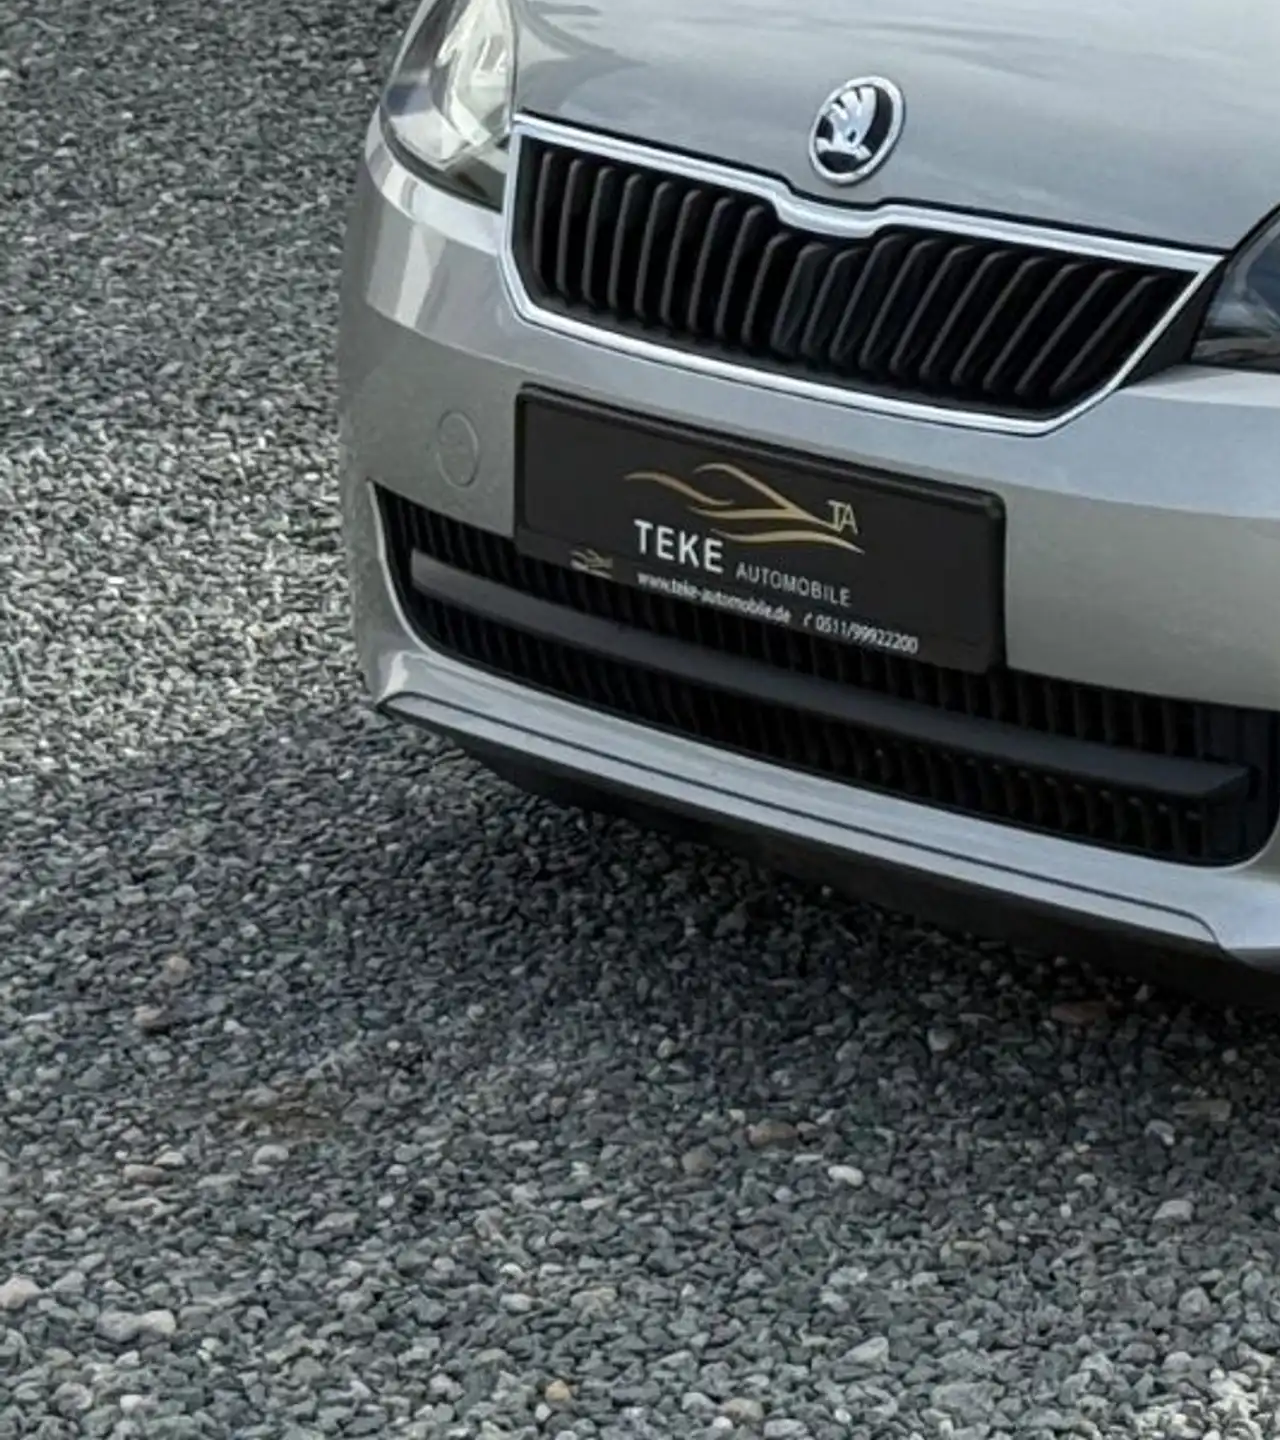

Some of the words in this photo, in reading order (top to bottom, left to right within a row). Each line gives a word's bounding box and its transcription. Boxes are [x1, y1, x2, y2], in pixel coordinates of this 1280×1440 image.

[826, 500, 859, 535] TA
[633, 519, 724, 574] TEKE
[735, 562, 852, 608] AUTOMOBILE
[637, 572, 792, 624] www.teke-automobile.de
